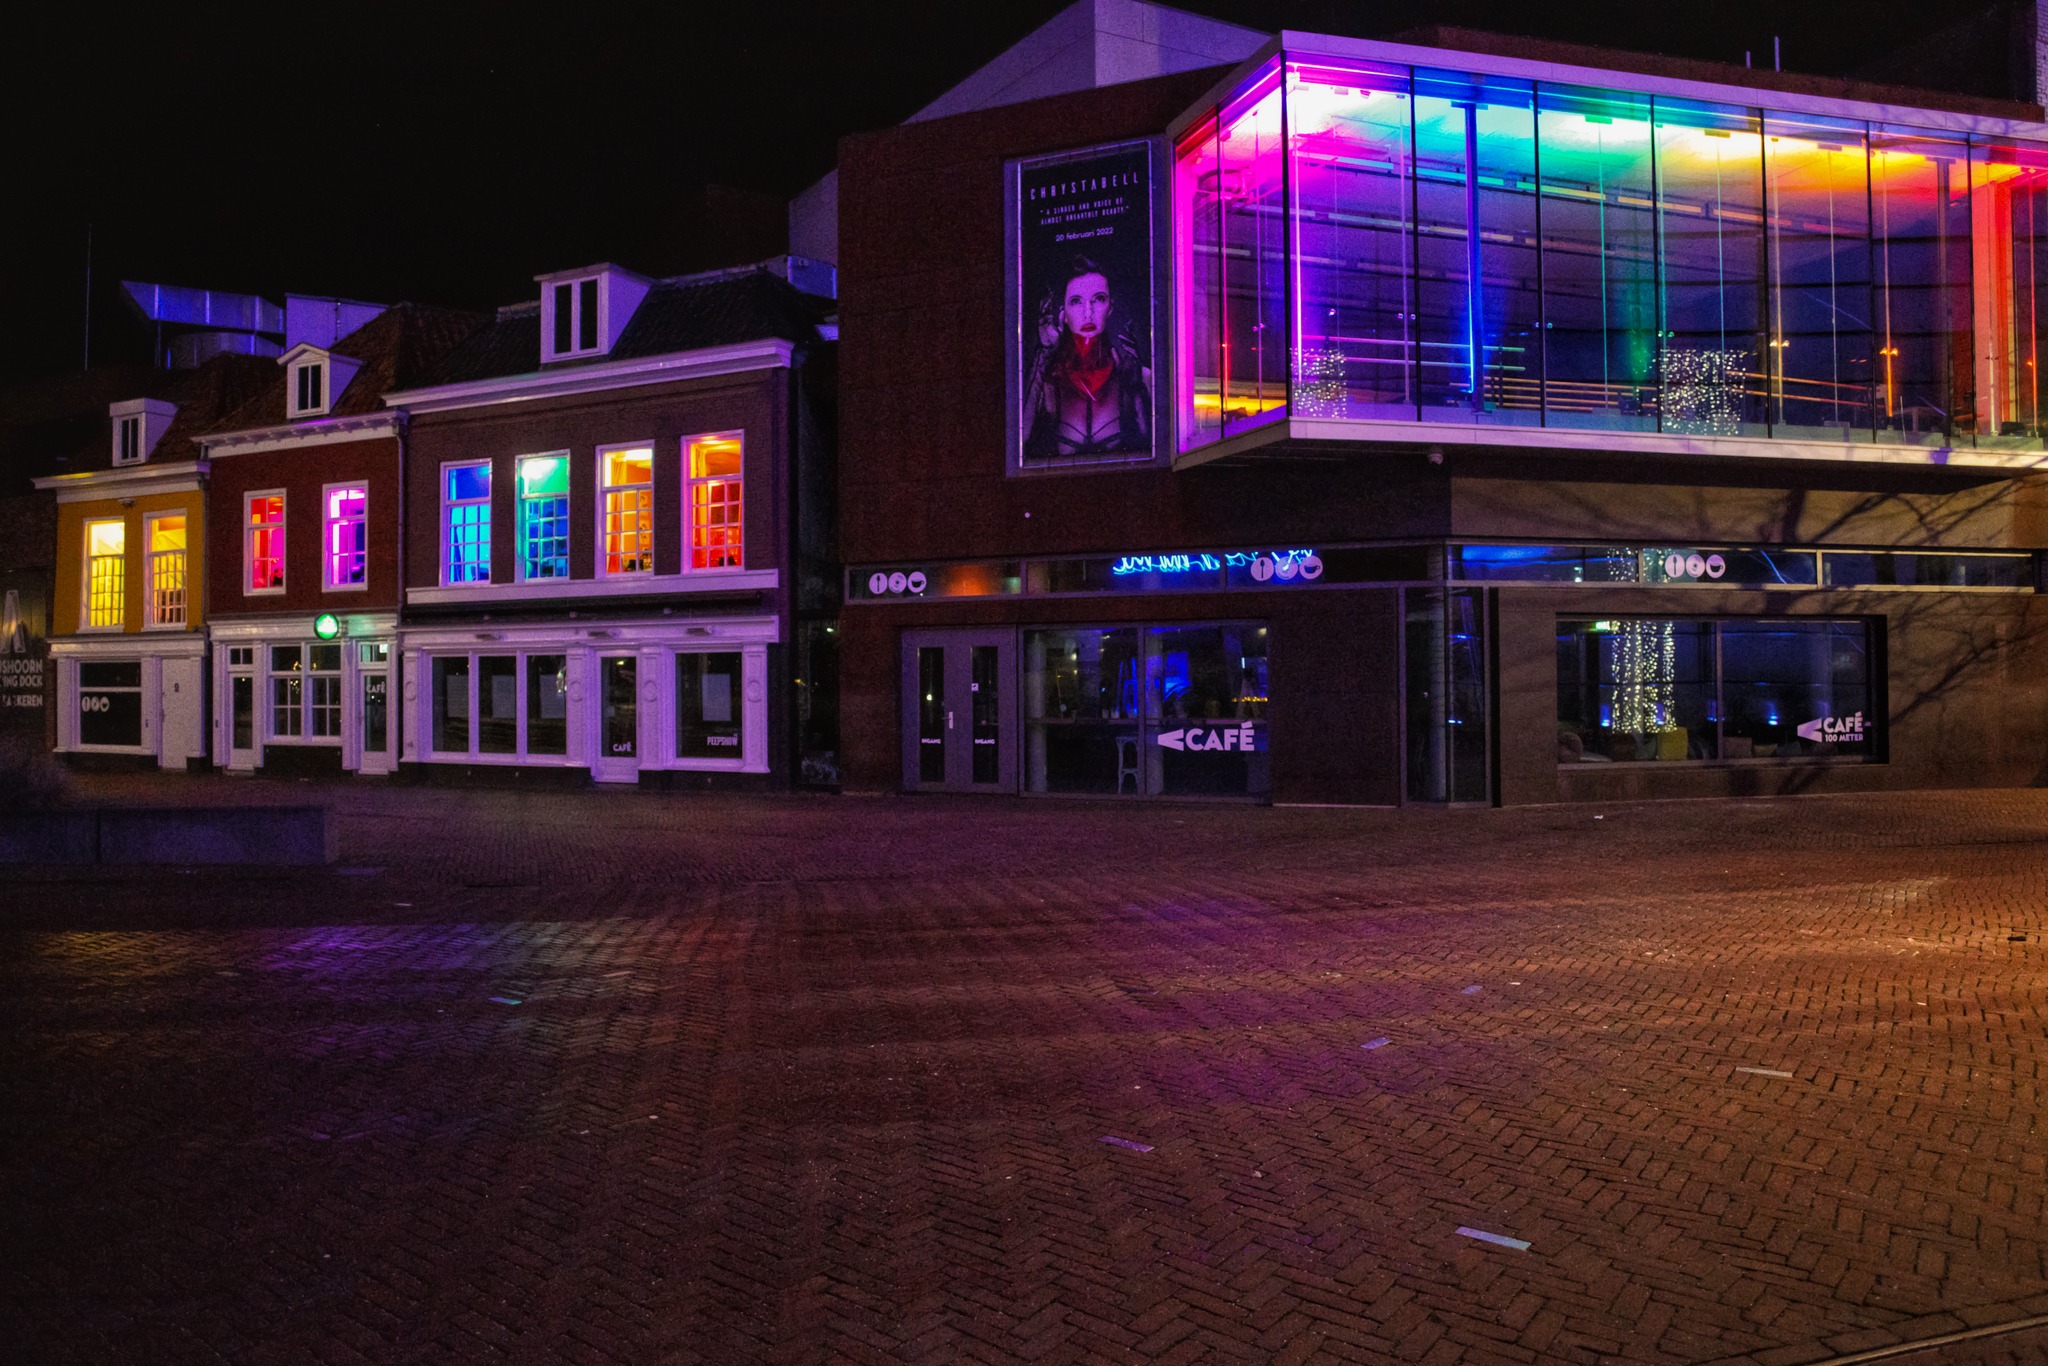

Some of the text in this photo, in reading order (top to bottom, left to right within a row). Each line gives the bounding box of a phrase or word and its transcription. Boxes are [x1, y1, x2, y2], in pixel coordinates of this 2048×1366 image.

[1030, 171, 1138, 201] CHRYSTABELL
[1055, 226, 1114, 242] 20 februari 2022
[20, 675, 43, 687] DOCK
[1823, 710, 1864, 733] CAFÉ
[1185, 720, 1255, 751] CAFÉ
[1825, 733, 1864, 742] 100 METER
